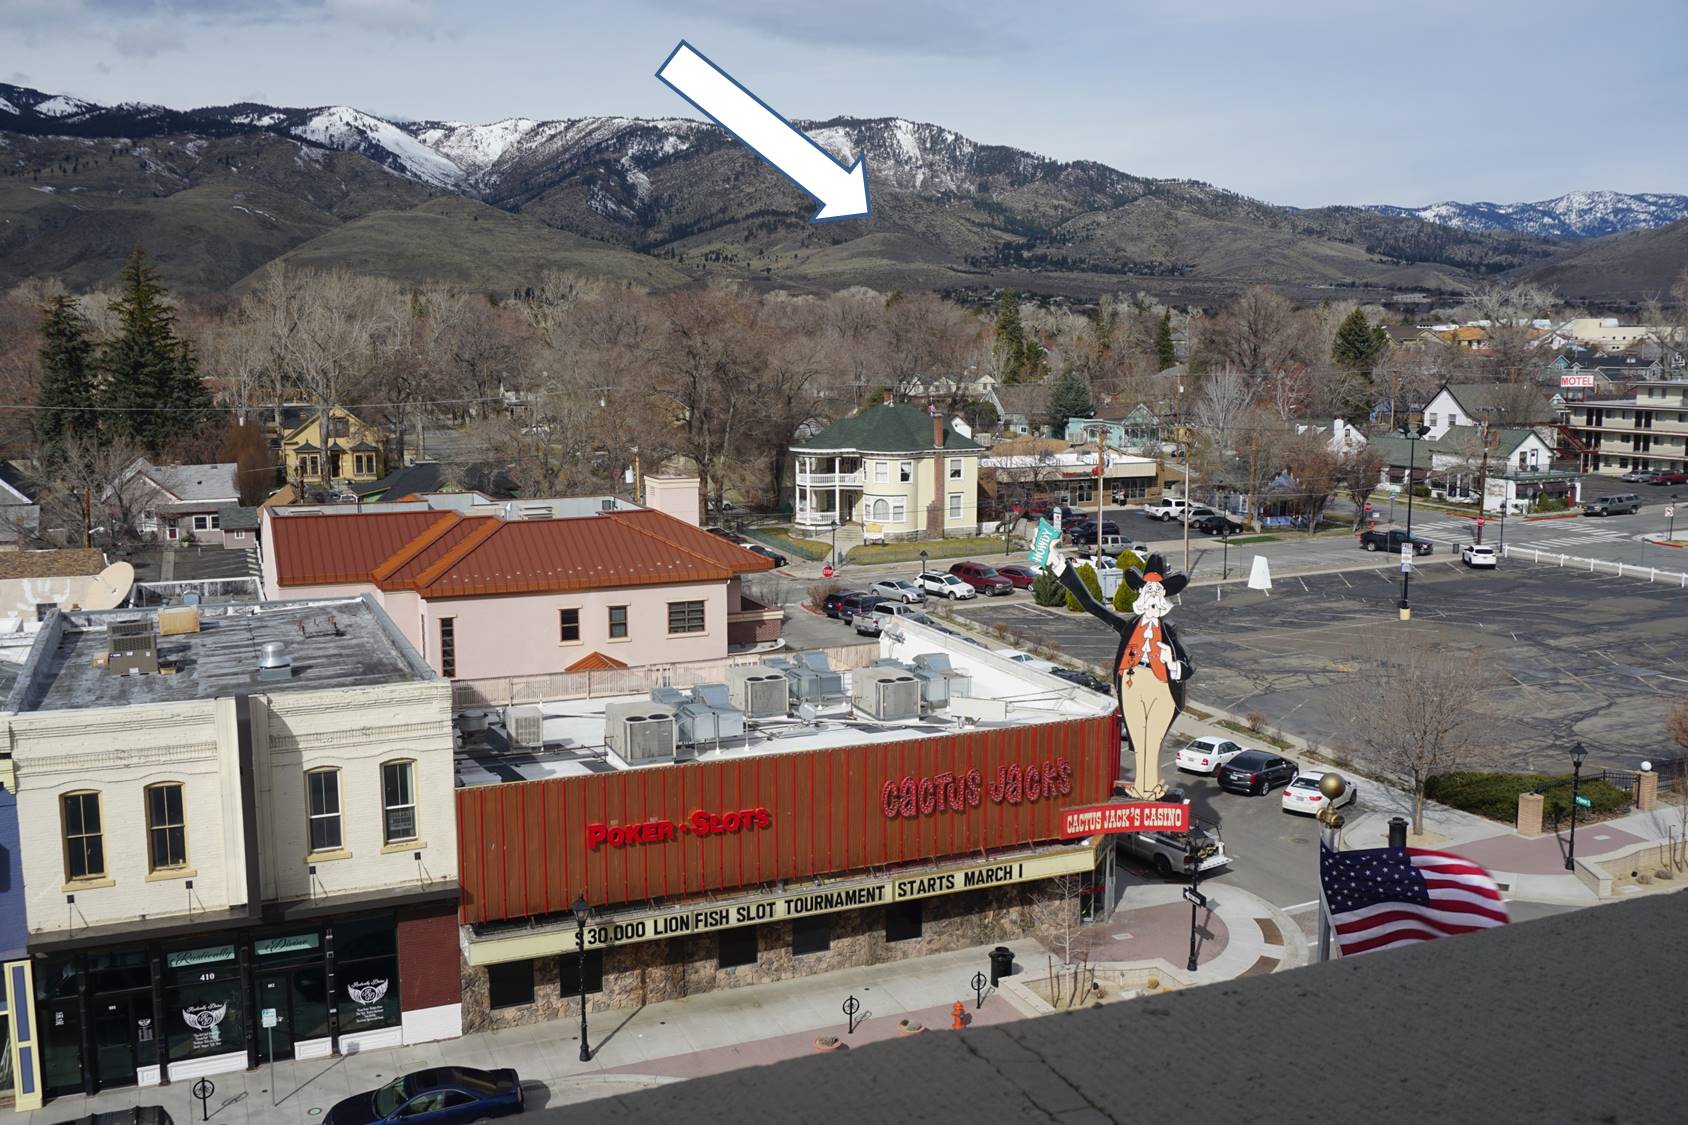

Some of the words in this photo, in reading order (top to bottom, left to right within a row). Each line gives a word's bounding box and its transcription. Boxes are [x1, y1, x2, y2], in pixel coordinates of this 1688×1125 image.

[1562, 377, 1592, 386] MOTEL
[1032, 528, 1052, 562] HOWDY
[587, 820, 675, 849] POKER
[690, 808, 770, 836] SLOTS
[1066, 811, 1102, 834] CACTUS
[1104, 807, 1141, 829] JACK'S
[1143, 808, 1182, 827] CASINO
[654, 914, 690, 936] LION
[694, 909, 730, 929] FISH
[736, 902, 776, 923] SLOT
[784, 885, 885, 915] TOURNAMENT
[898, 874, 955, 898] STARTS
[963, 865, 1013, 888] MARCH
[200, 972, 215, 981] 410
